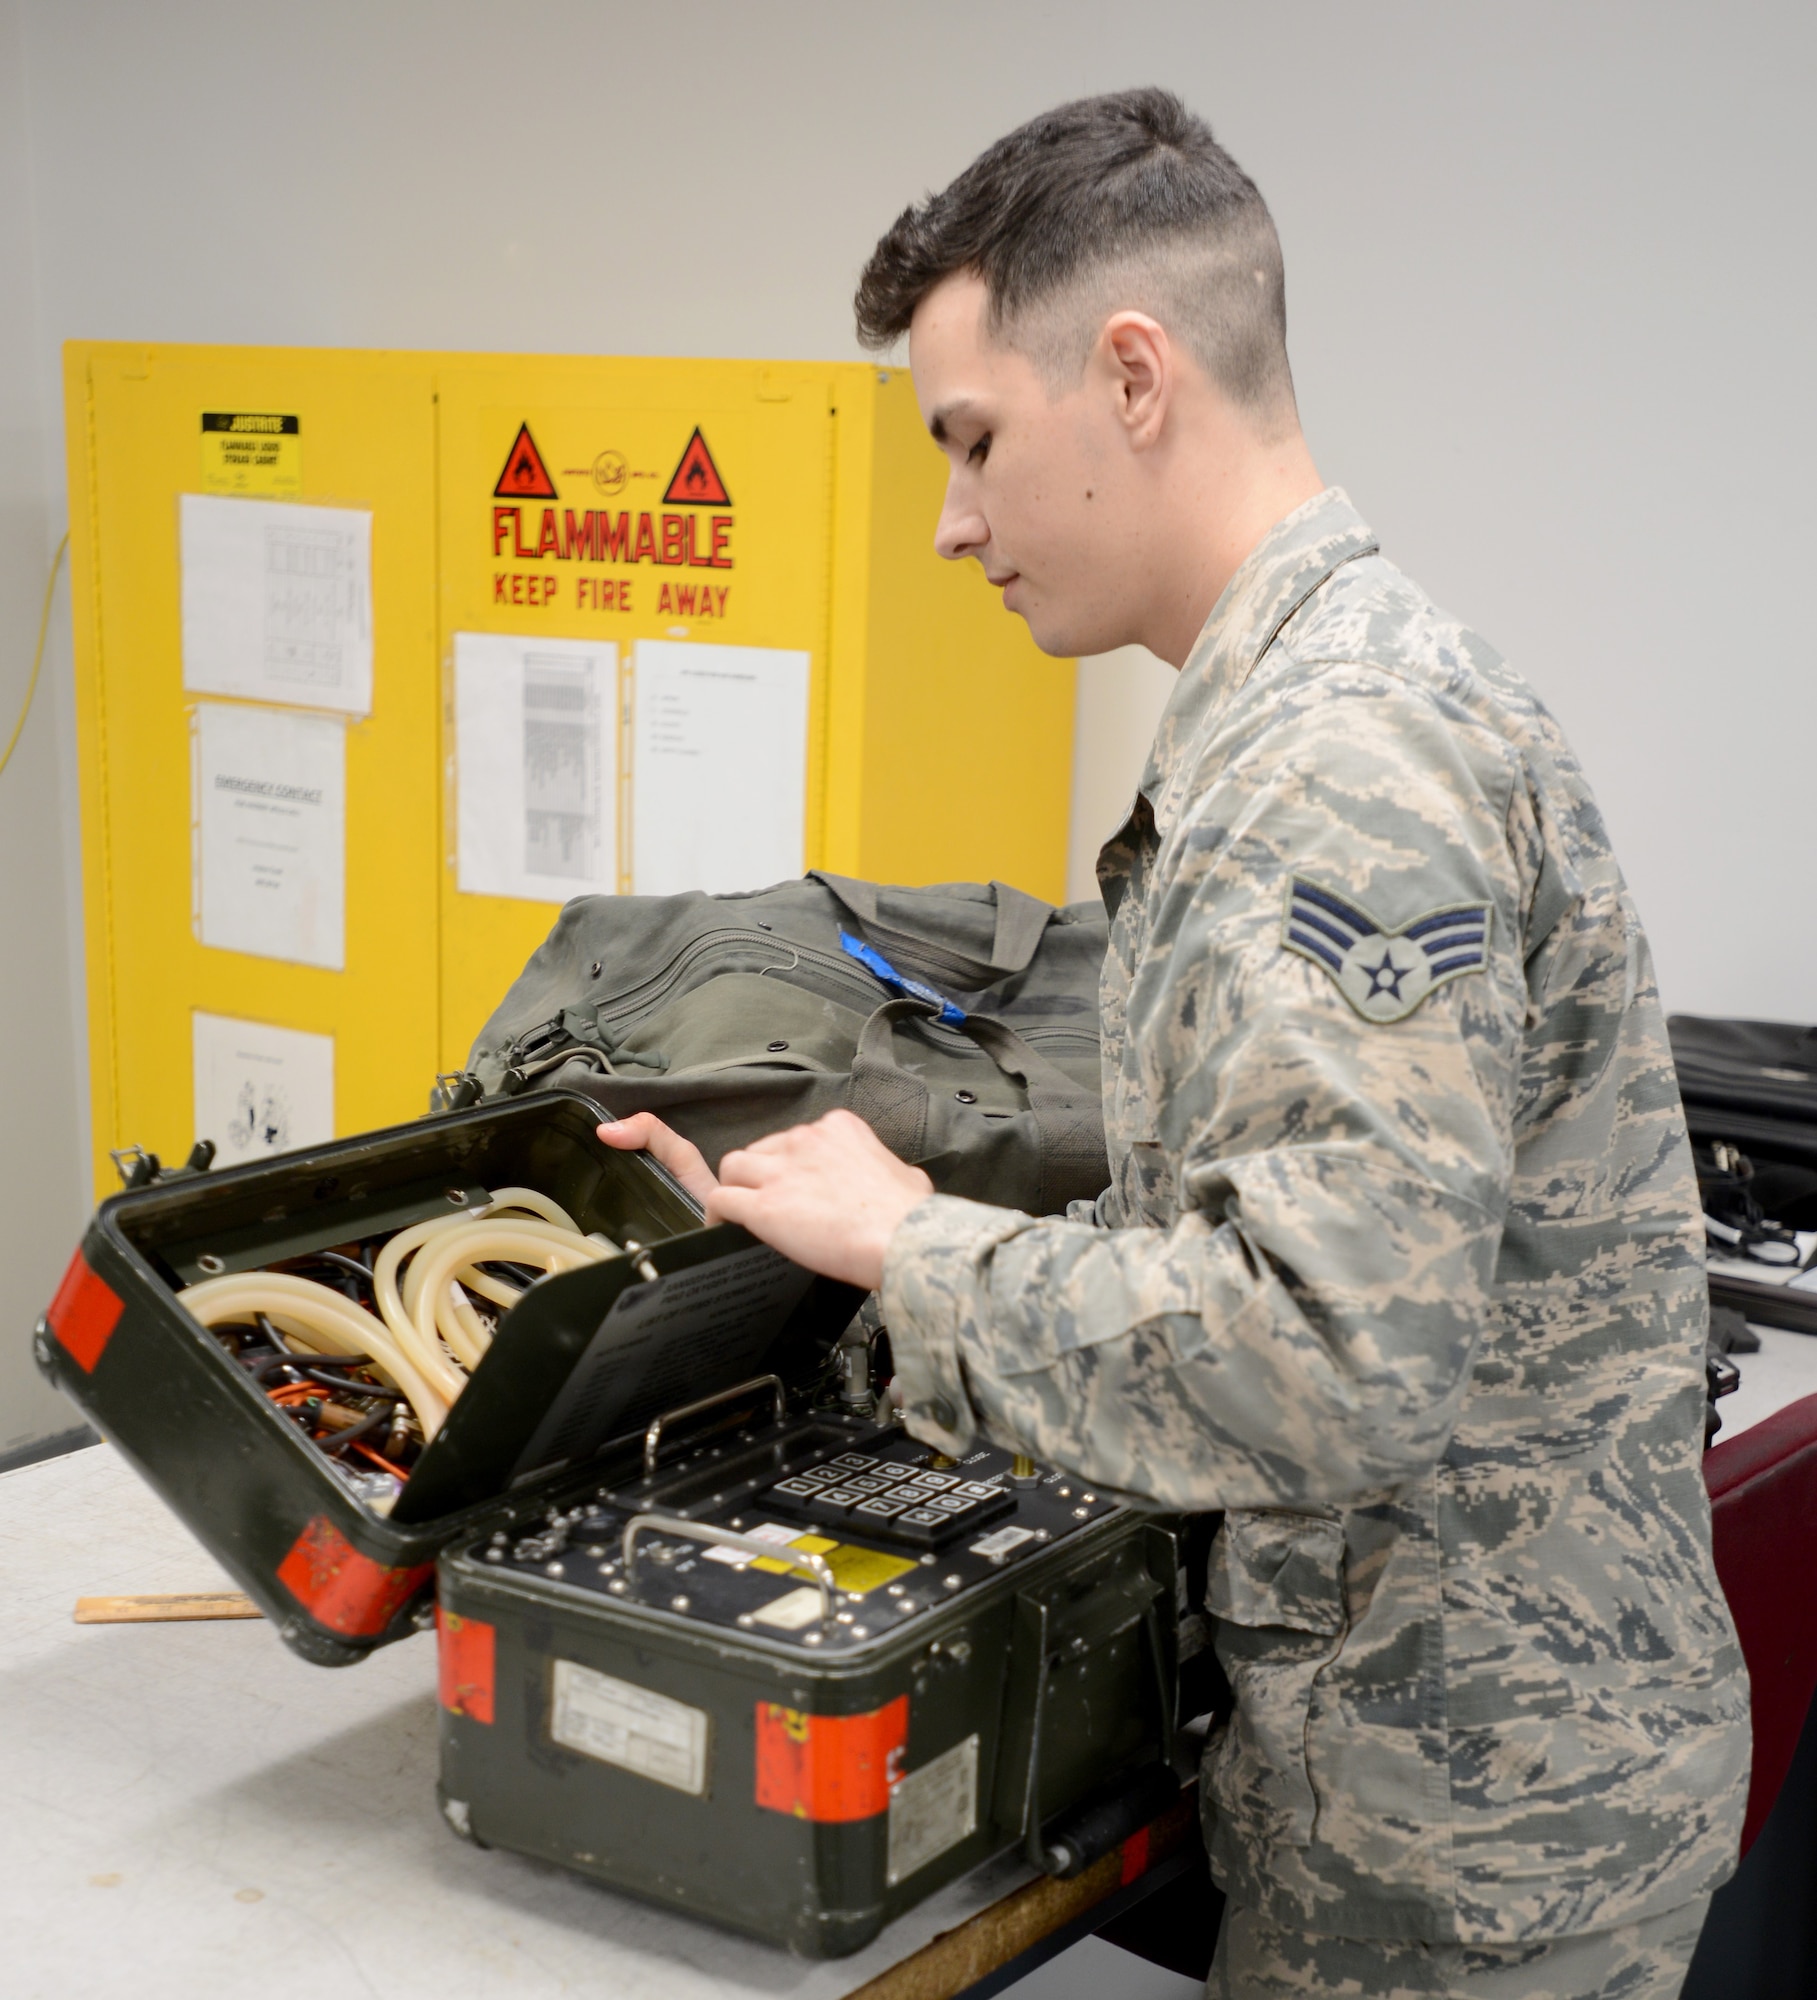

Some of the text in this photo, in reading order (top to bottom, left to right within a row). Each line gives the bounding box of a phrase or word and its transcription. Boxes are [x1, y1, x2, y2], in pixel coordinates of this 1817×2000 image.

[493, 507, 733, 568] FLAMMABLE
[494, 573, 730, 618] KEEP FIRE AWAY
[790, 1456, 864, 1491] 1 2 3
[832, 1466, 903, 1501] 4 5 6
[871, 1476, 945, 1511] 7 8 9
